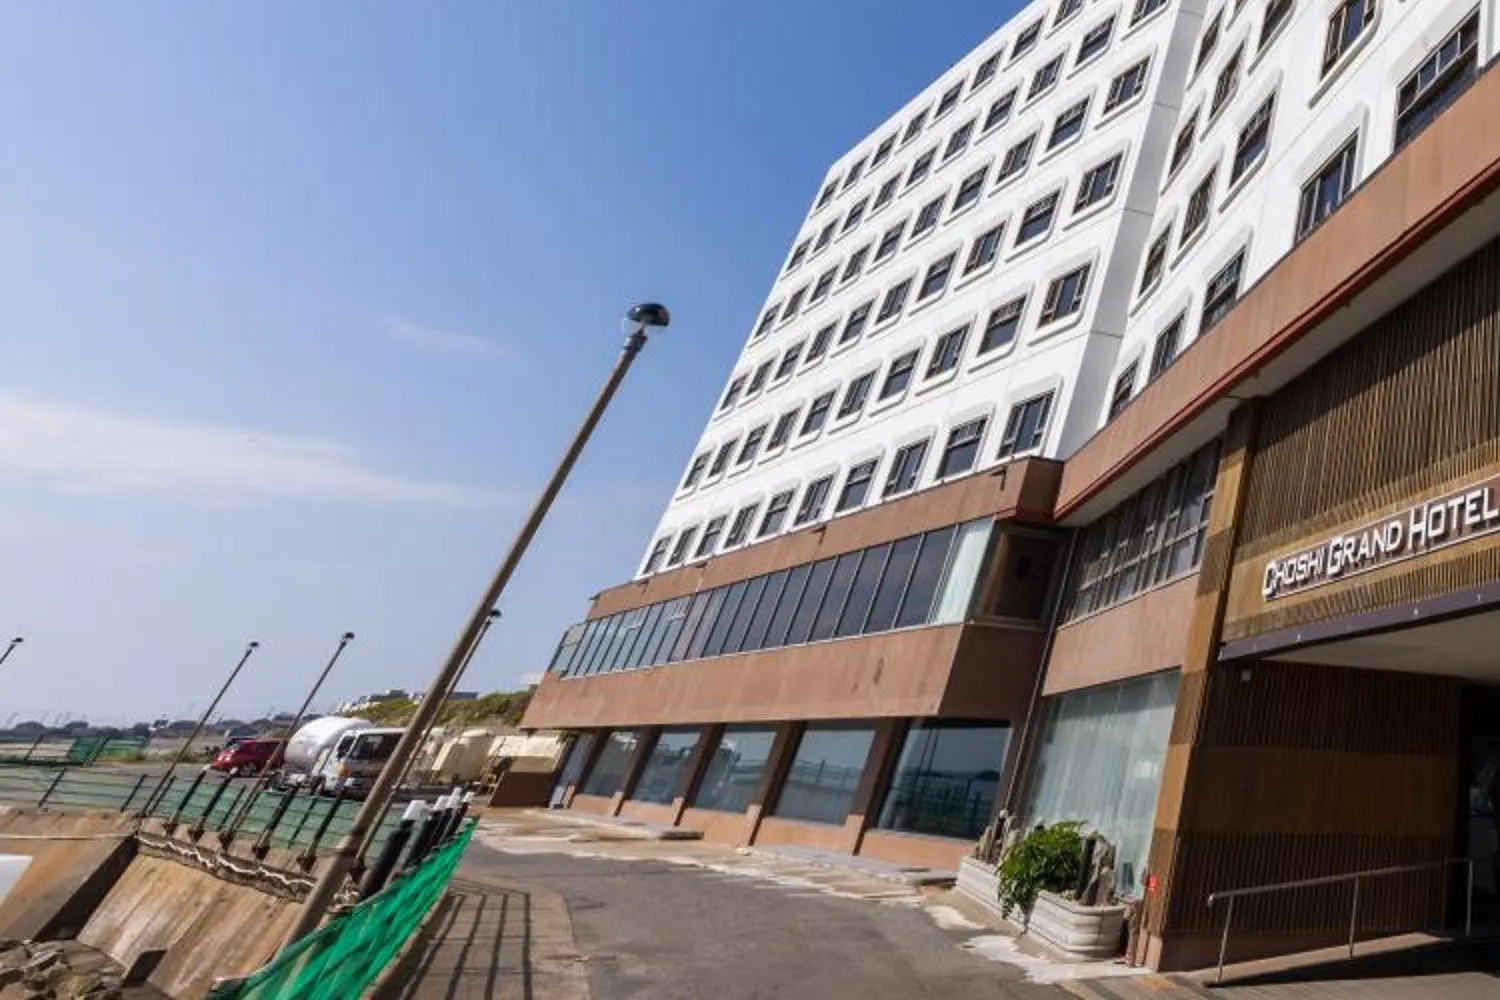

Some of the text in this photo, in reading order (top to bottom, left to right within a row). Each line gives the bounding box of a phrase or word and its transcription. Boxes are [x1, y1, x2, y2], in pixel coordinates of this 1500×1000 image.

[1262, 487, 1499, 597] CHOSHI GRAND HOTEL
